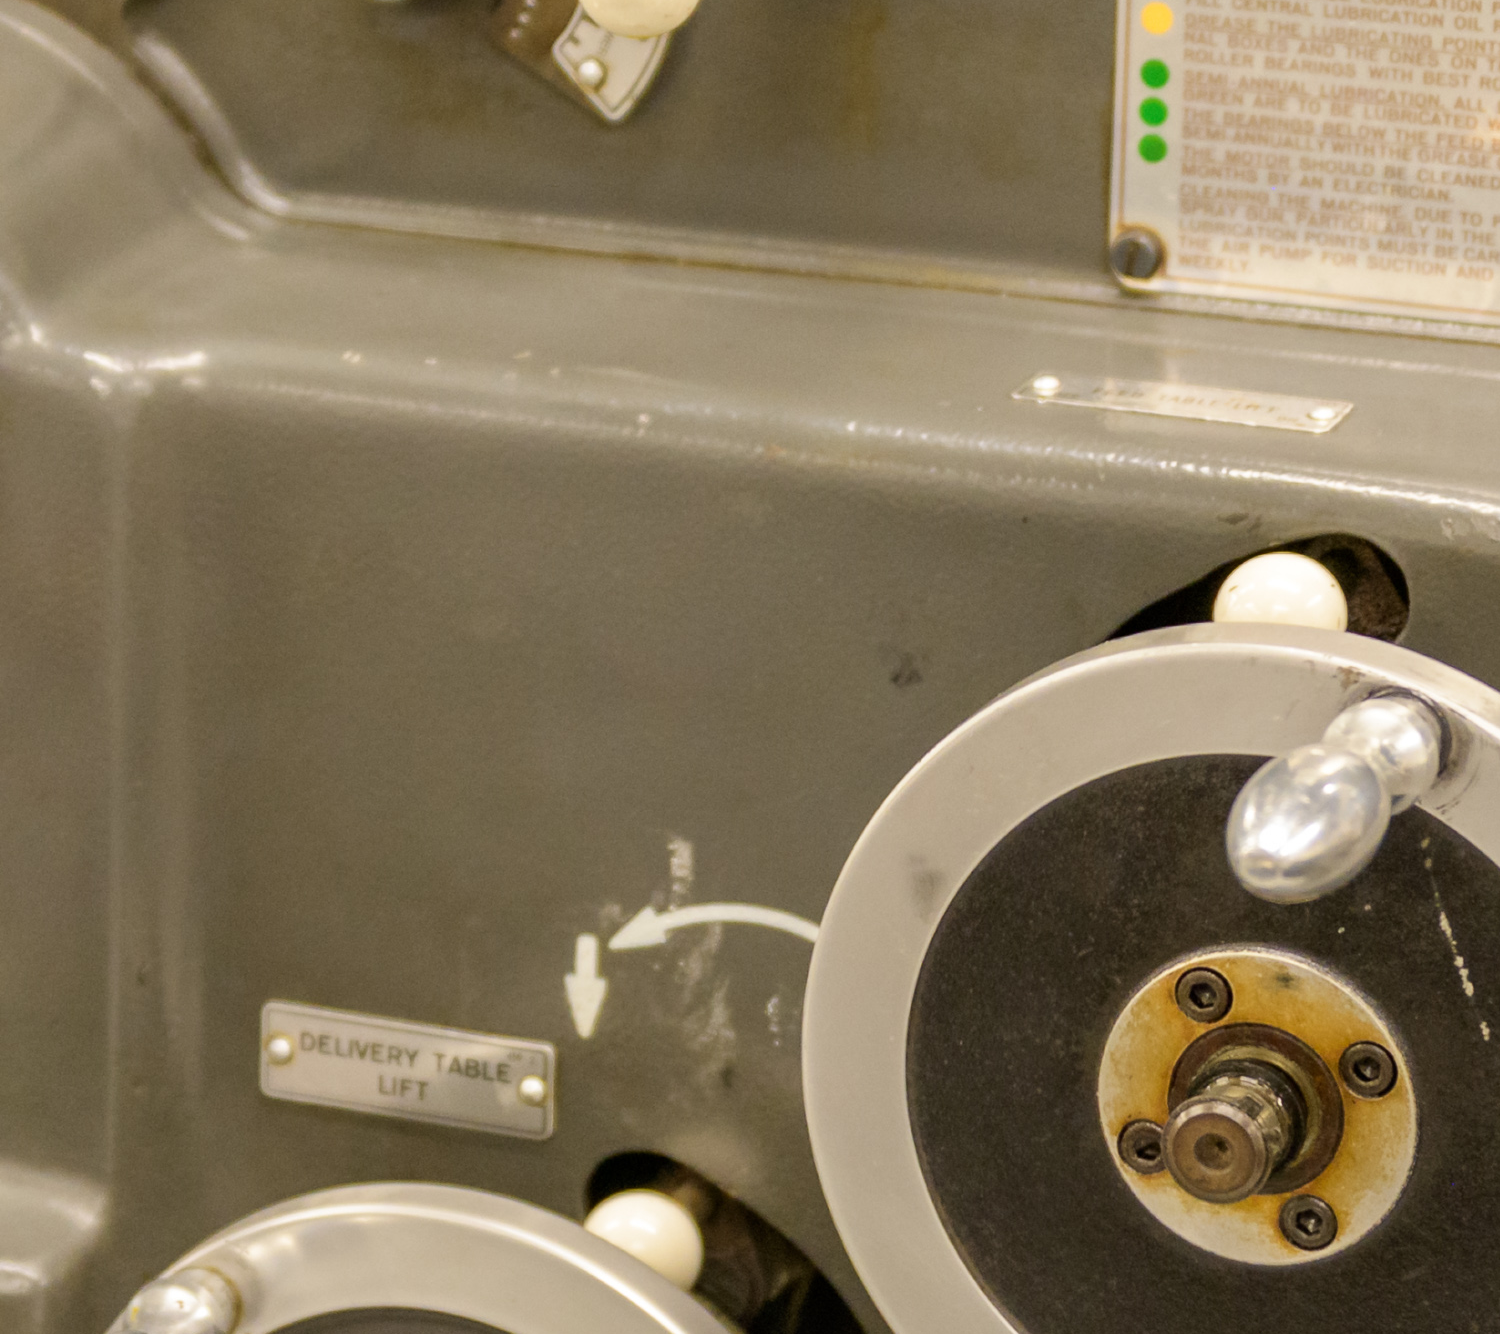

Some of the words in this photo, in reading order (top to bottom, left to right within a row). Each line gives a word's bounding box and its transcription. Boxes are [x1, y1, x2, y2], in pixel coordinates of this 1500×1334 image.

[301, 1030, 420, 1068] DELIVERY
[434, 1052, 512, 1085] TABLE
[377, 1074, 430, 1101] LIFT
